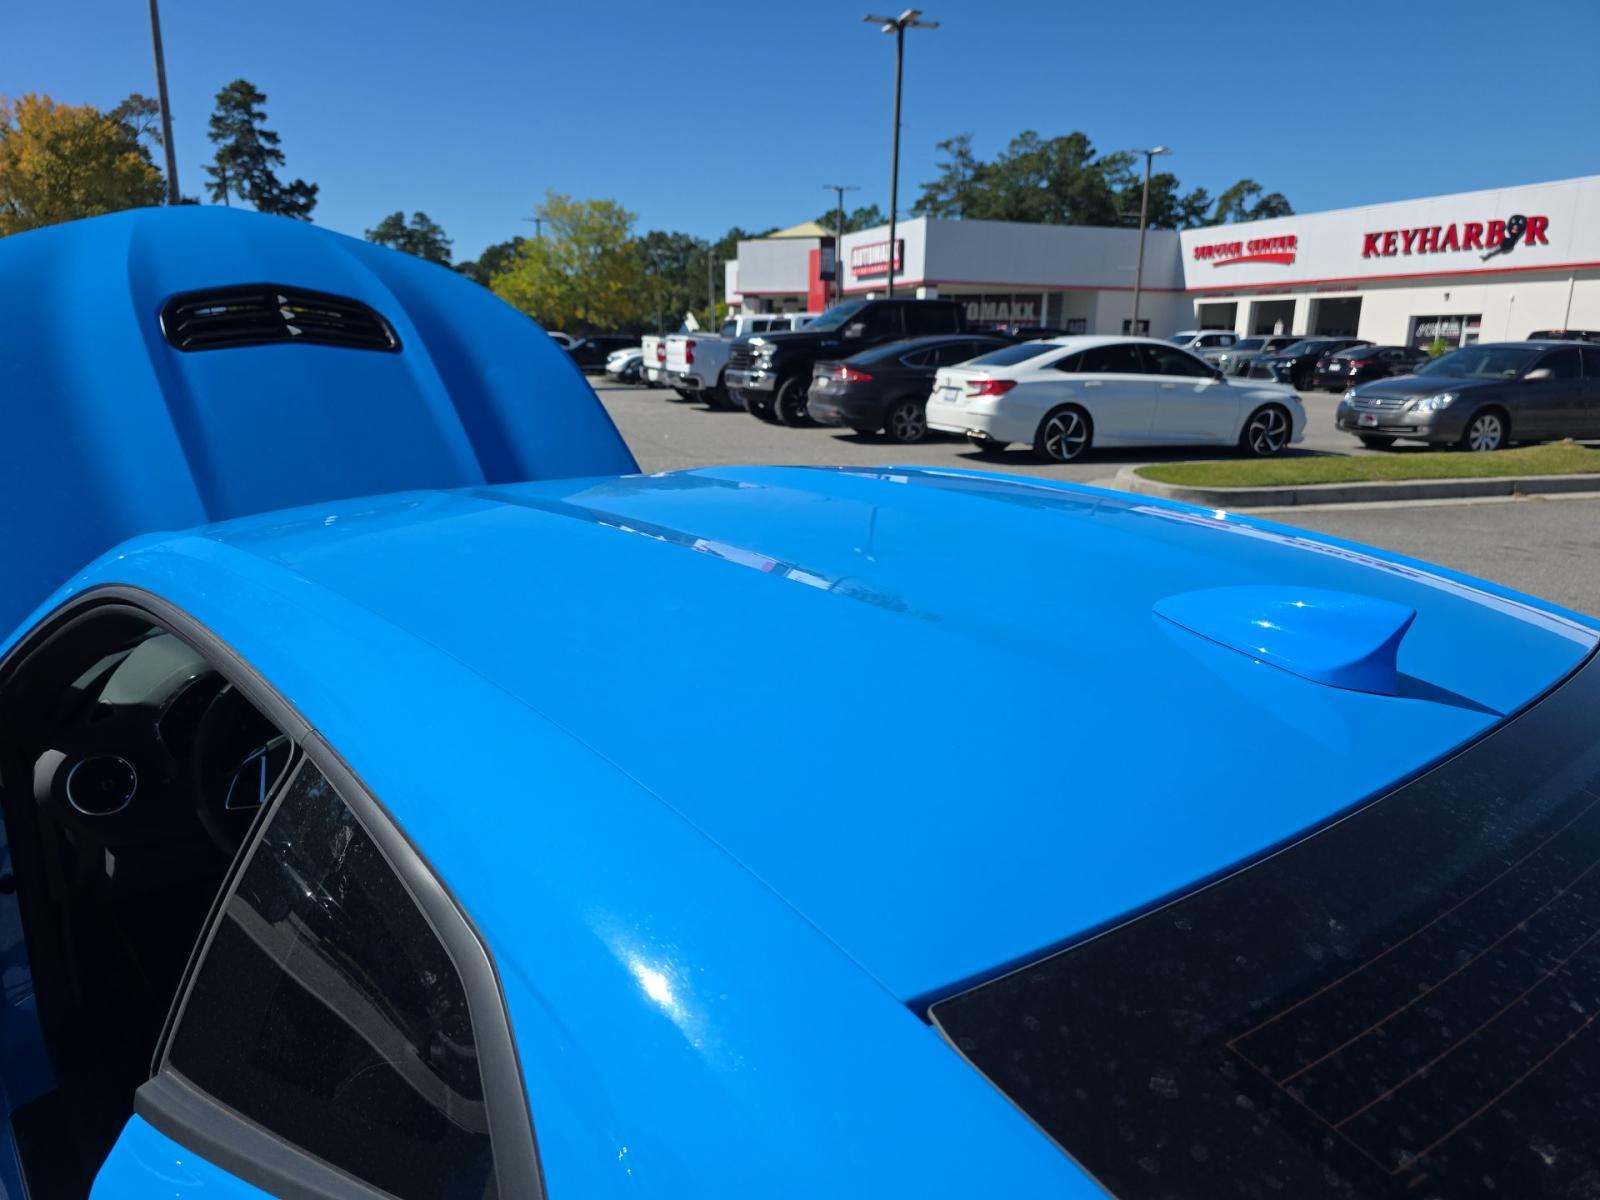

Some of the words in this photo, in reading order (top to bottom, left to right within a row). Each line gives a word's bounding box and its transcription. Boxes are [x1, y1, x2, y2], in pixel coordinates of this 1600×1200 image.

[1194, 242, 1243, 260] SERVICE
[1247, 235, 1297, 254] CENTER
[1361, 214, 1550, 259] KEYHARBOR
